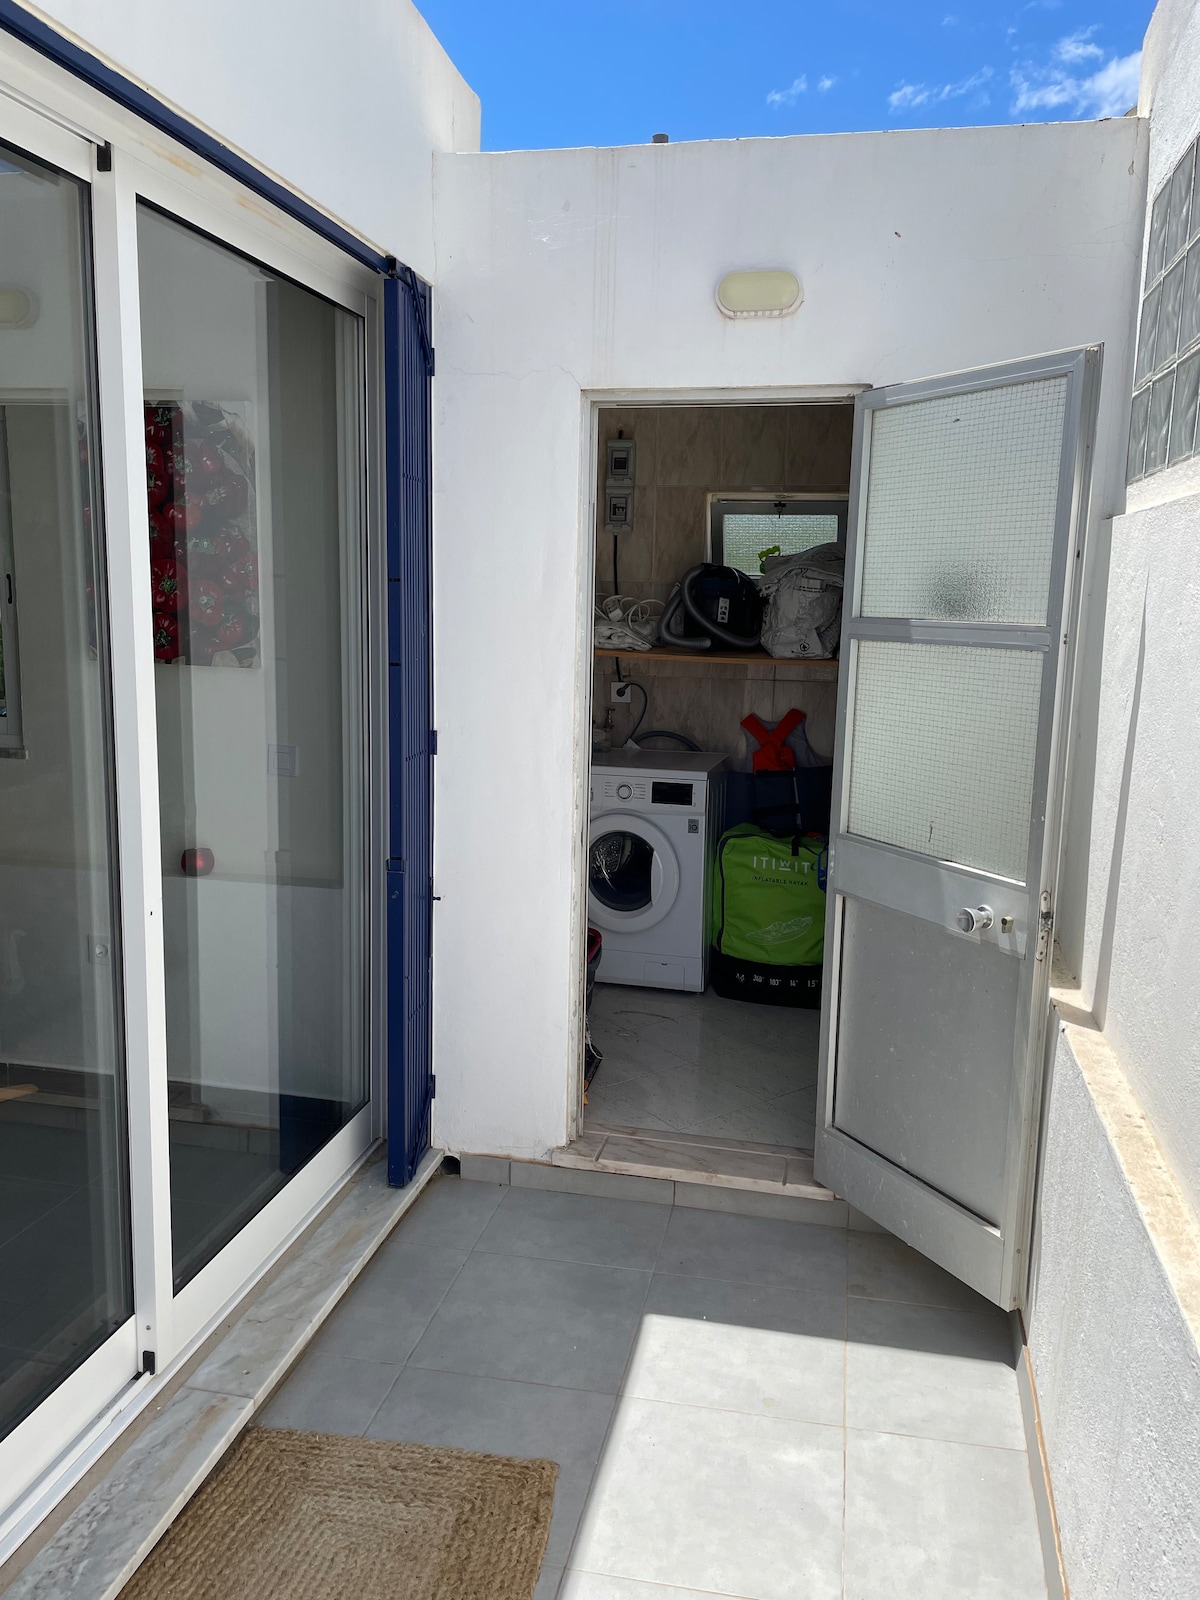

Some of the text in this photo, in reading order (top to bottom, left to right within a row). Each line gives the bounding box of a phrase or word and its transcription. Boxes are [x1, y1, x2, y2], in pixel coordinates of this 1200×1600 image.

[753, 856, 810, 874] ITIWIT
[752, 875, 809, 887] INFLATABLE KAYAK
